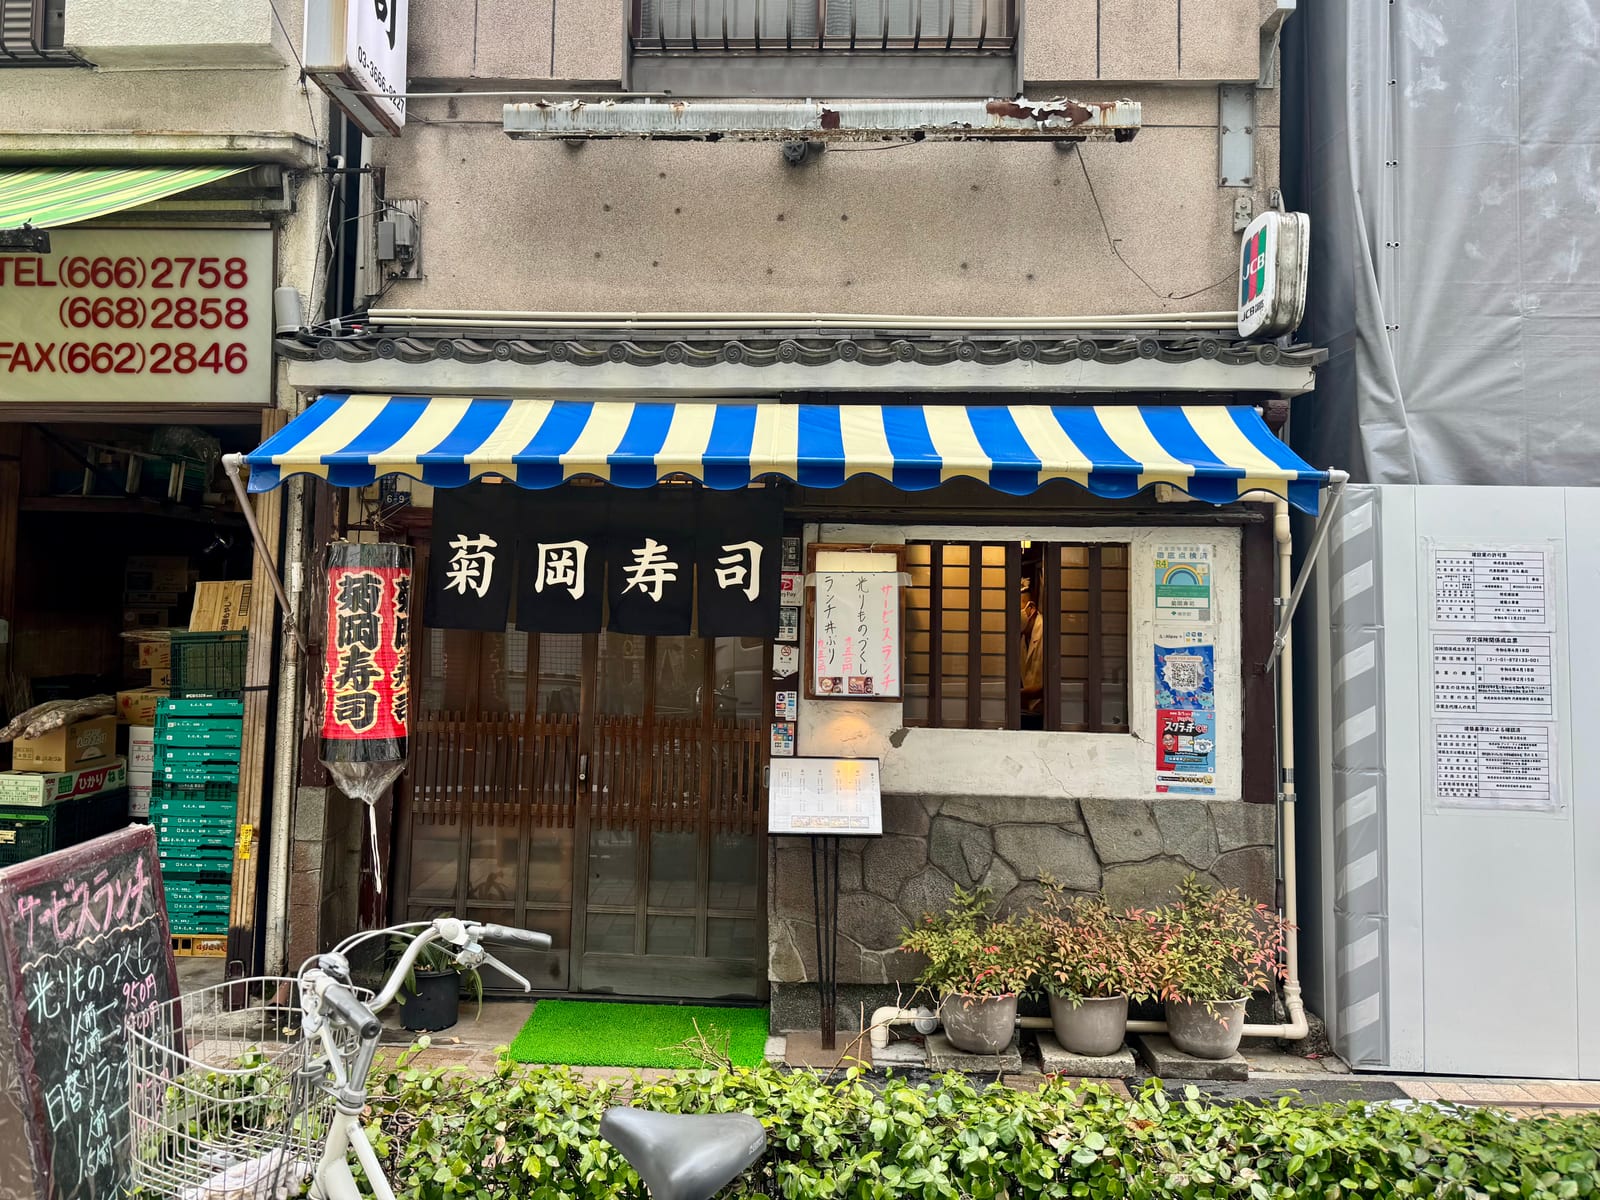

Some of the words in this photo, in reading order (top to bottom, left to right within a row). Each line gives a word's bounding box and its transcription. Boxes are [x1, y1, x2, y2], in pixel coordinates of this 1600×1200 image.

[1242, 252, 1265, 280] JCB
[59, 296, 248, 329] (668)2858
[1241, 305, 1255, 321] JCB
[443, 533, 763, 602] 菊岡寿司
[335, 574, 383, 731] 菊岡寿司
[122, 972, 157, 1010] 950円
